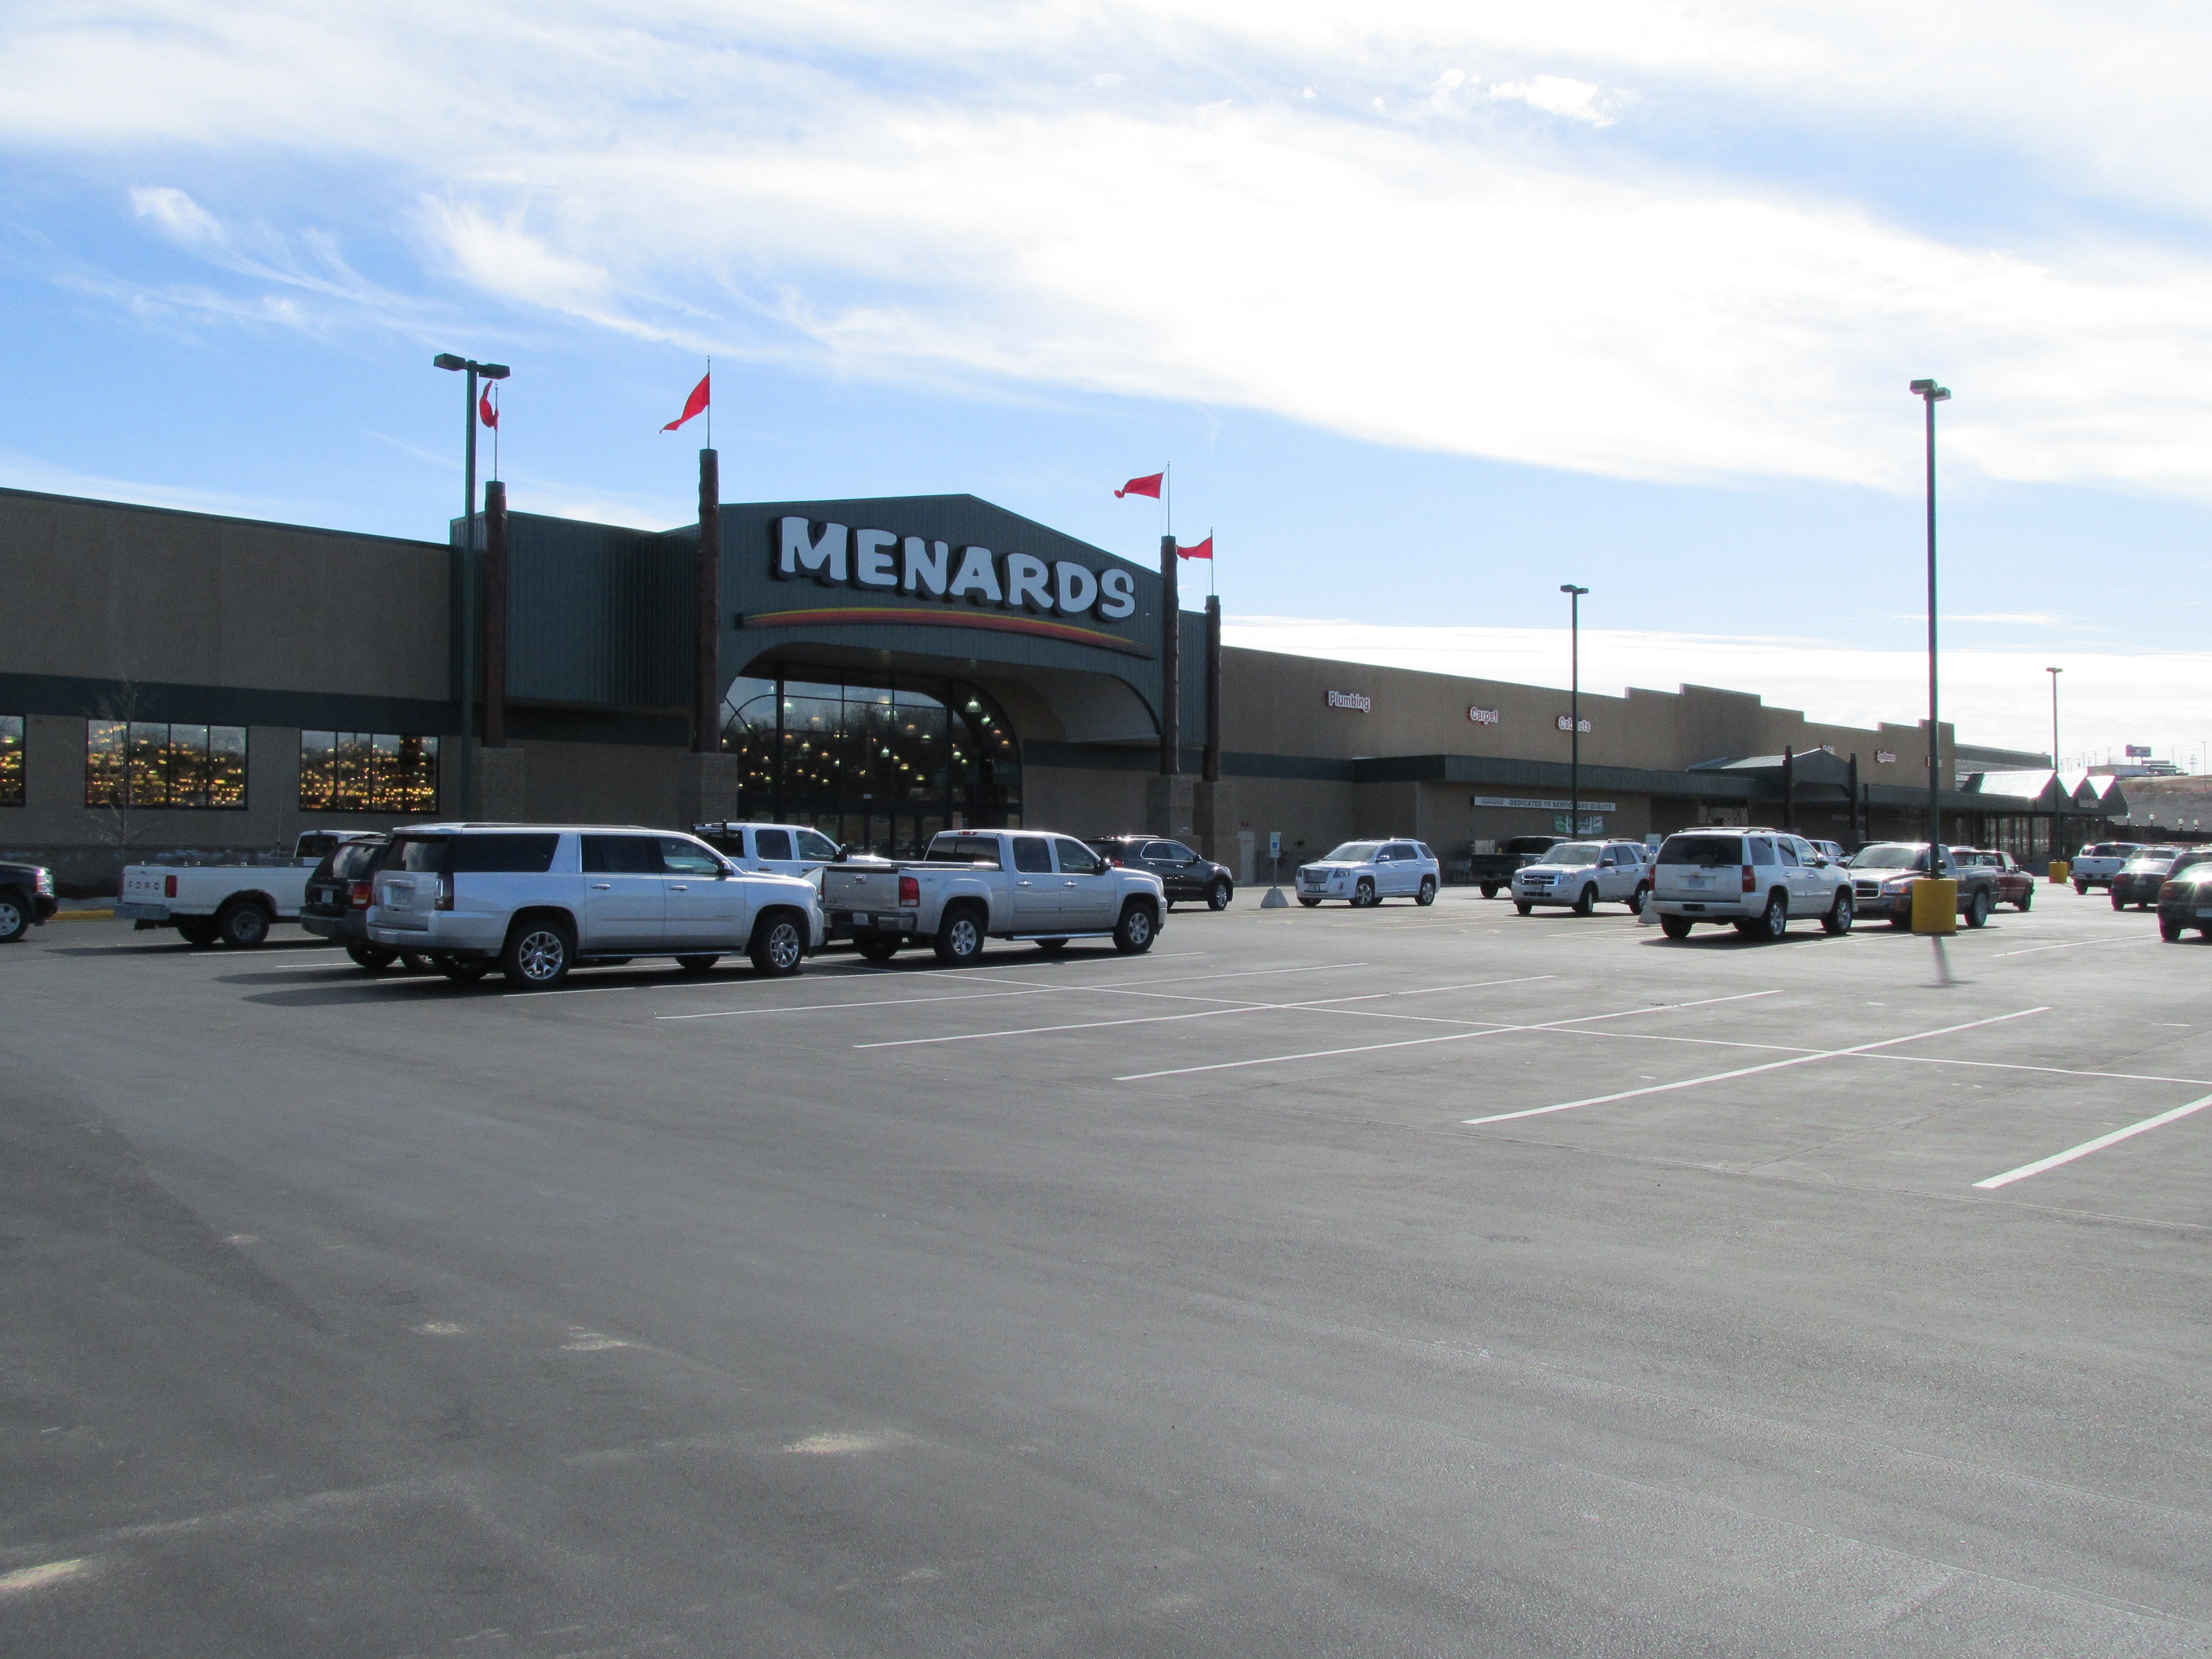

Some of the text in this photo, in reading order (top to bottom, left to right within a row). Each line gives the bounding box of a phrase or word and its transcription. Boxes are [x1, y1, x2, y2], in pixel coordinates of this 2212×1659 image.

[779, 516, 1136, 619] MENARDS
[1328, 691, 1370, 713] Plumbing
[1470, 707, 1498, 724] Carpet
[1558, 716, 1591, 733] Cabets
[1510, 799, 1542, 807] DEDICATED
[128, 881, 159, 890] FORD
